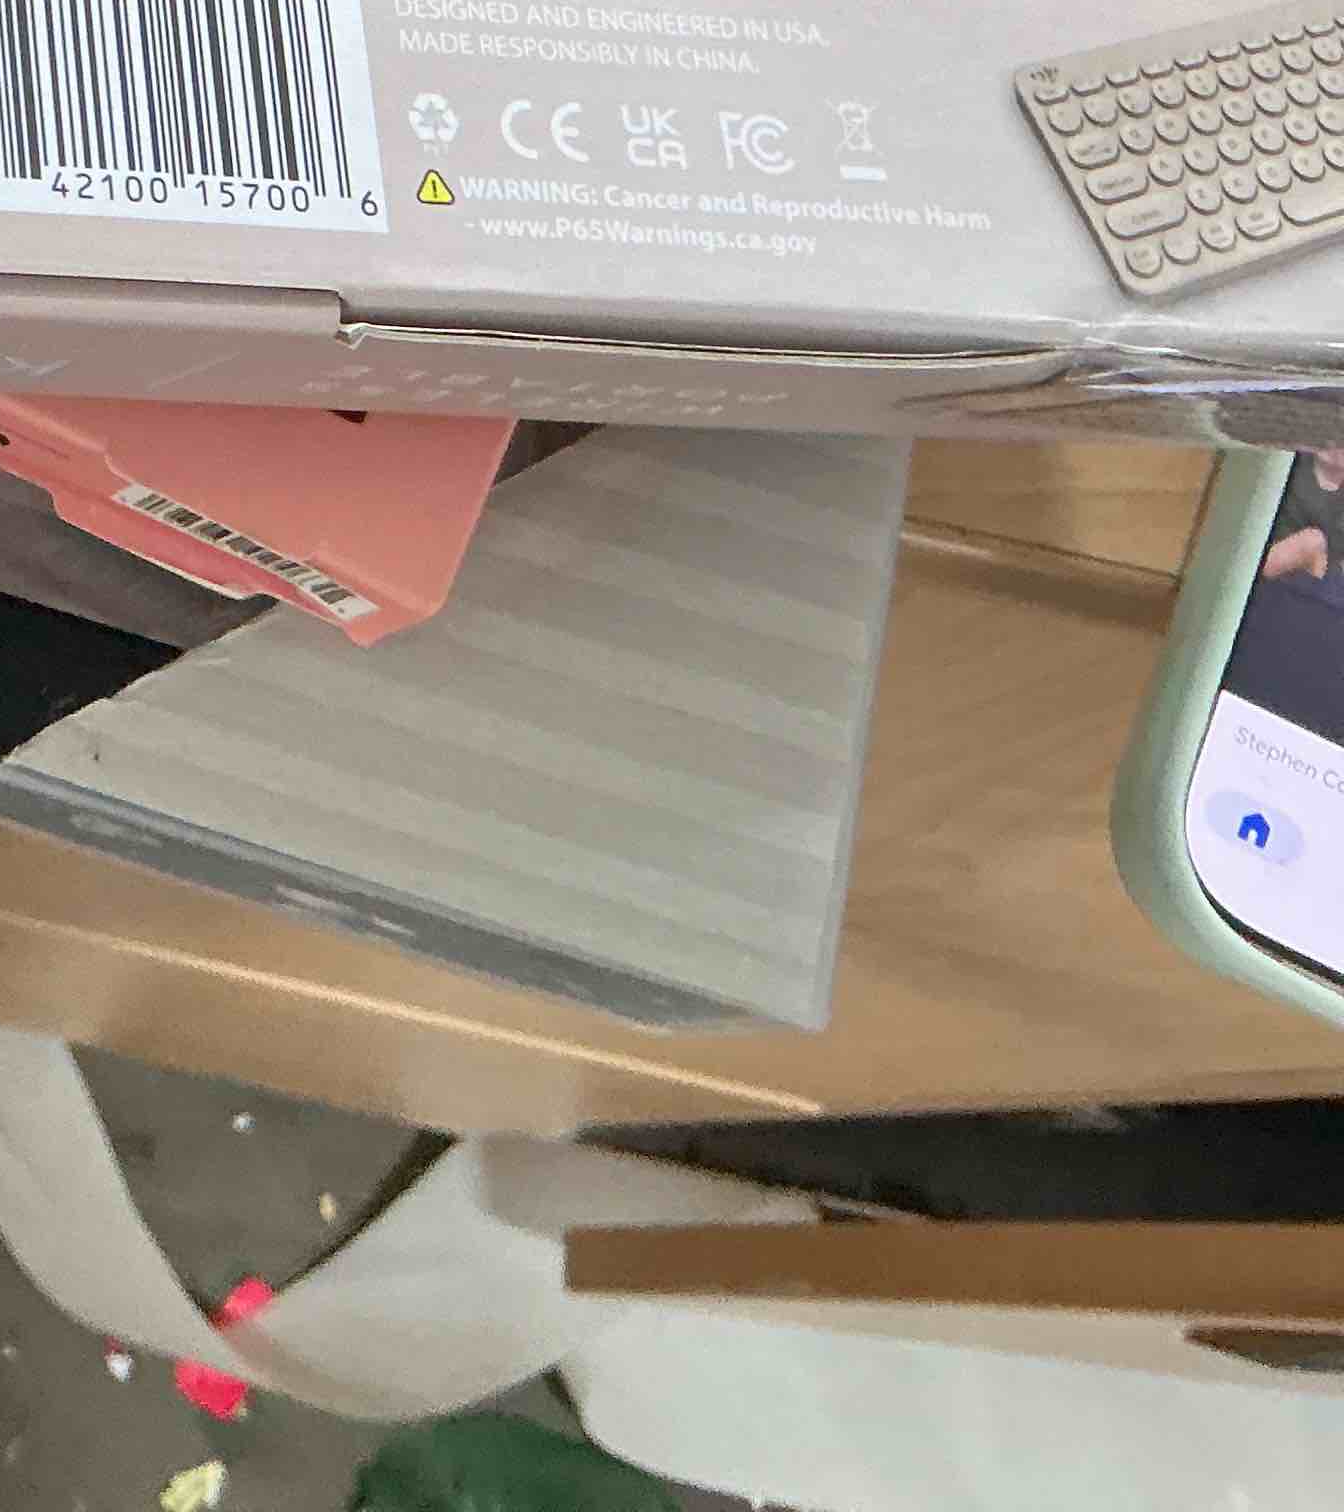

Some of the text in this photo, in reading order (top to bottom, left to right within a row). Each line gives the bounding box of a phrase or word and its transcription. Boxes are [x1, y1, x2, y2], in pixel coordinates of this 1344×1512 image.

[526, 2, 580, 29] AND
[587, 8, 738, 41] ENGINEERED
[744, 18, 770, 42] IN
[773, 21, 831, 49] USA.
[398, 28, 761, 76] MADE RESPONSIBLY IN CHINA.
[51, 171, 311, 214] 42100 15700
[459, 174, 992, 232] WARNING: Cancer and Reproductive Harm
[1235, 725, 1318, 780] Stephen
